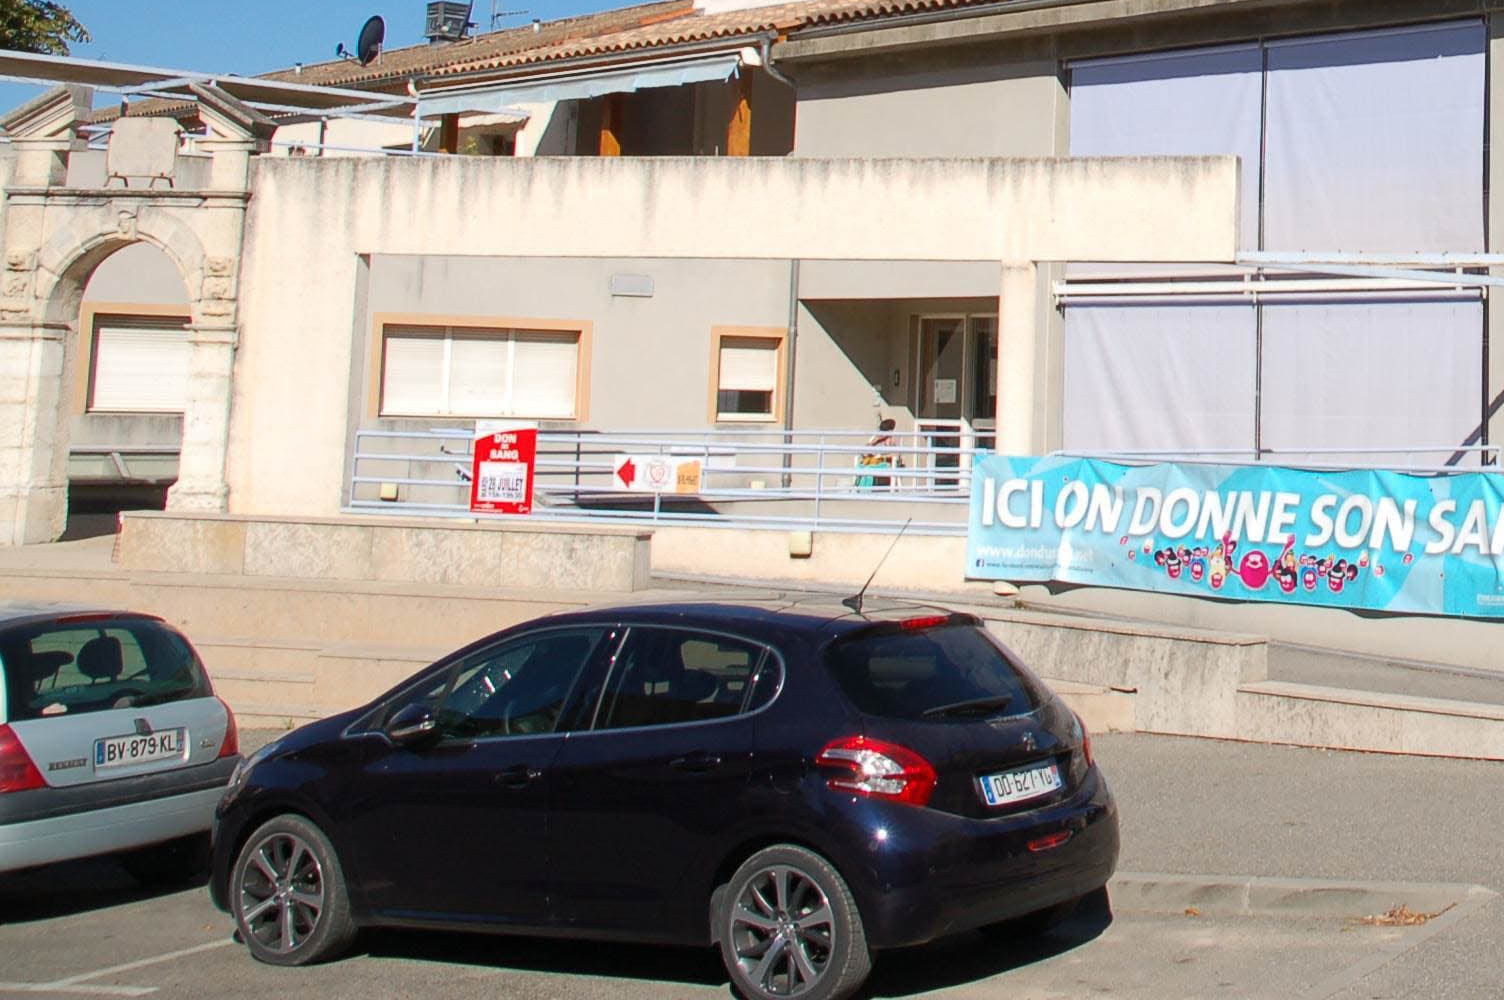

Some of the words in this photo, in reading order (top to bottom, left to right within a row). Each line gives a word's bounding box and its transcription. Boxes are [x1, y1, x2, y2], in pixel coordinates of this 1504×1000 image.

[493, 433, 517, 444] DON
[489, 449, 519, 460] SANG
[982, 476, 1044, 529] ICI
[1054, 479, 1121, 533] ON
[1128, 480, 1302, 543] DONNE
[1306, 492, 1417, 551] SON
[107, 735, 176, 762] BV-879-KL
